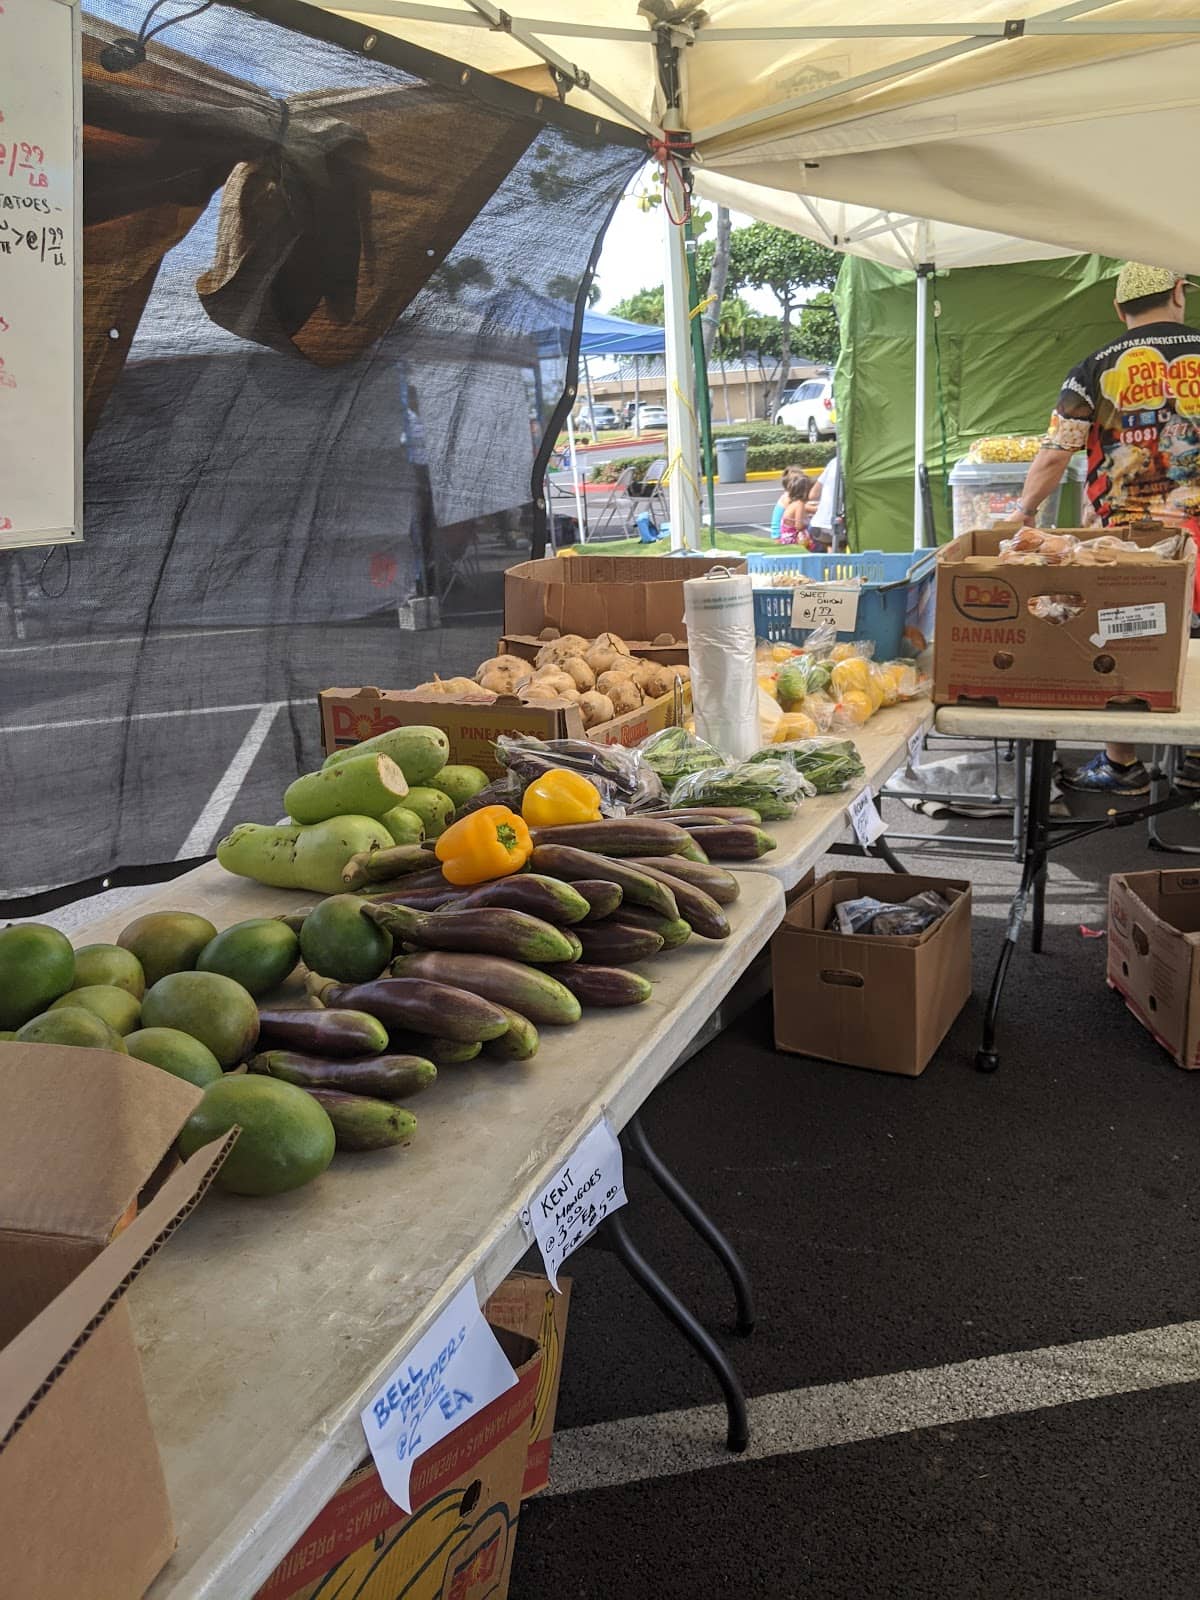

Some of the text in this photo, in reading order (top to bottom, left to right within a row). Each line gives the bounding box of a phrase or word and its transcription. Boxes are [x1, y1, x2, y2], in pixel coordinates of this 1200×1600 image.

[800, 590, 827, 599] SWEET
[963, 585, 1012, 605] Dole
[951, 627, 1026, 644] BANANAS
[540, 1168, 576, 1218] KENT
[555, 1168, 602, 1226] MANGOES
[562, 1230, 584, 1258] FOR
[373, 1365, 424, 1430] BELL
[439, 1388, 475, 1421] EA
